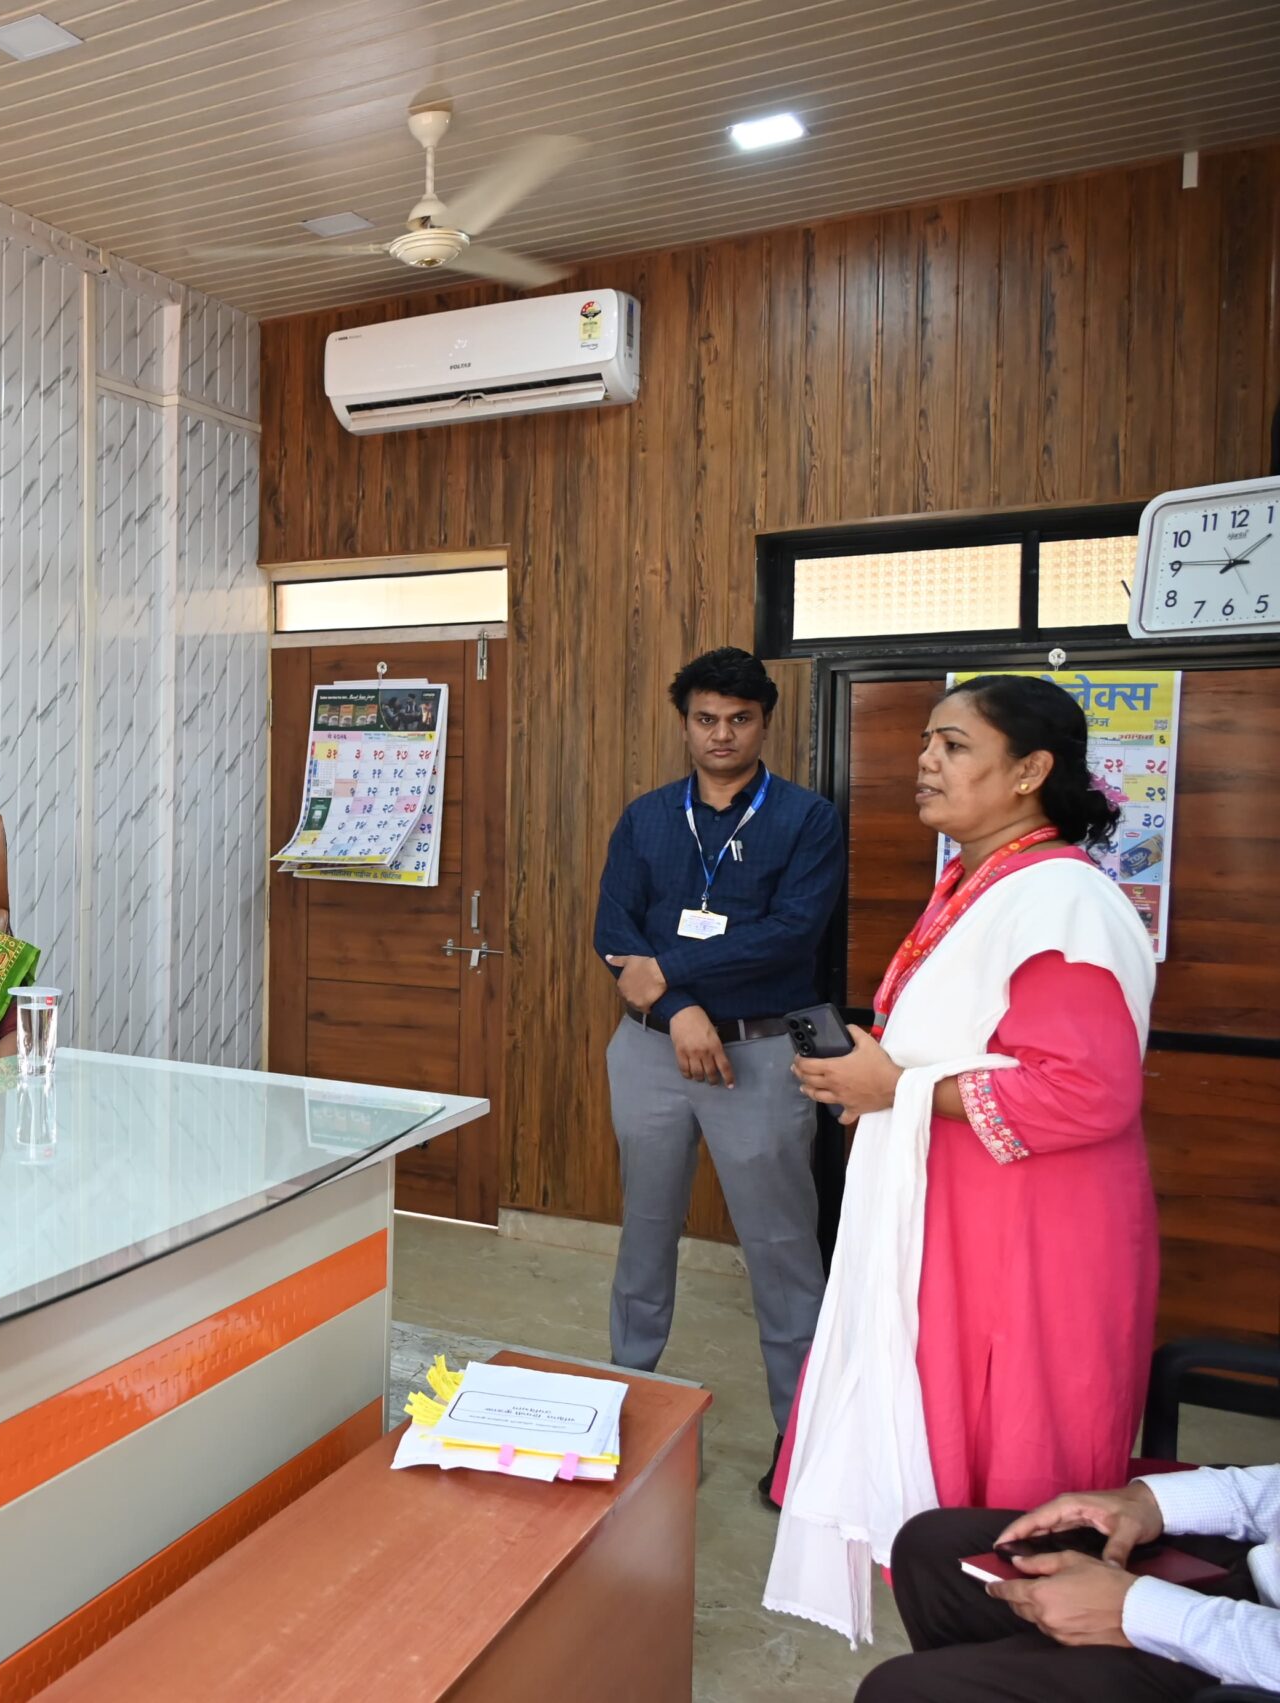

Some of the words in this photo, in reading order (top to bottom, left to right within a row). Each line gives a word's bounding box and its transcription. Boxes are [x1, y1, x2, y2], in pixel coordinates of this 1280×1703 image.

[1202, 513, 1218, 532] 11
[1231, 509, 1250, 529] 12
[1267, 506, 1274, 524] 1
[1173, 530, 1191, 548] 10
[1170, 560, 1182, 577] 9
[1165, 590, 1177, 607] 8
[1222, 598, 1234, 616] 6
[1254, 594, 1269, 613] 5
[1193, 600, 1206, 618] 7
[373, 750, 384, 760] १०
[1104, 759, 1123, 772] २१
[1145, 759, 1167, 774] २८
[1146, 787, 1166, 801] २९
[1142, 813, 1165, 829] ३०
[416, 842, 429, 853] ३०
[414, 860, 426, 871] ३१
